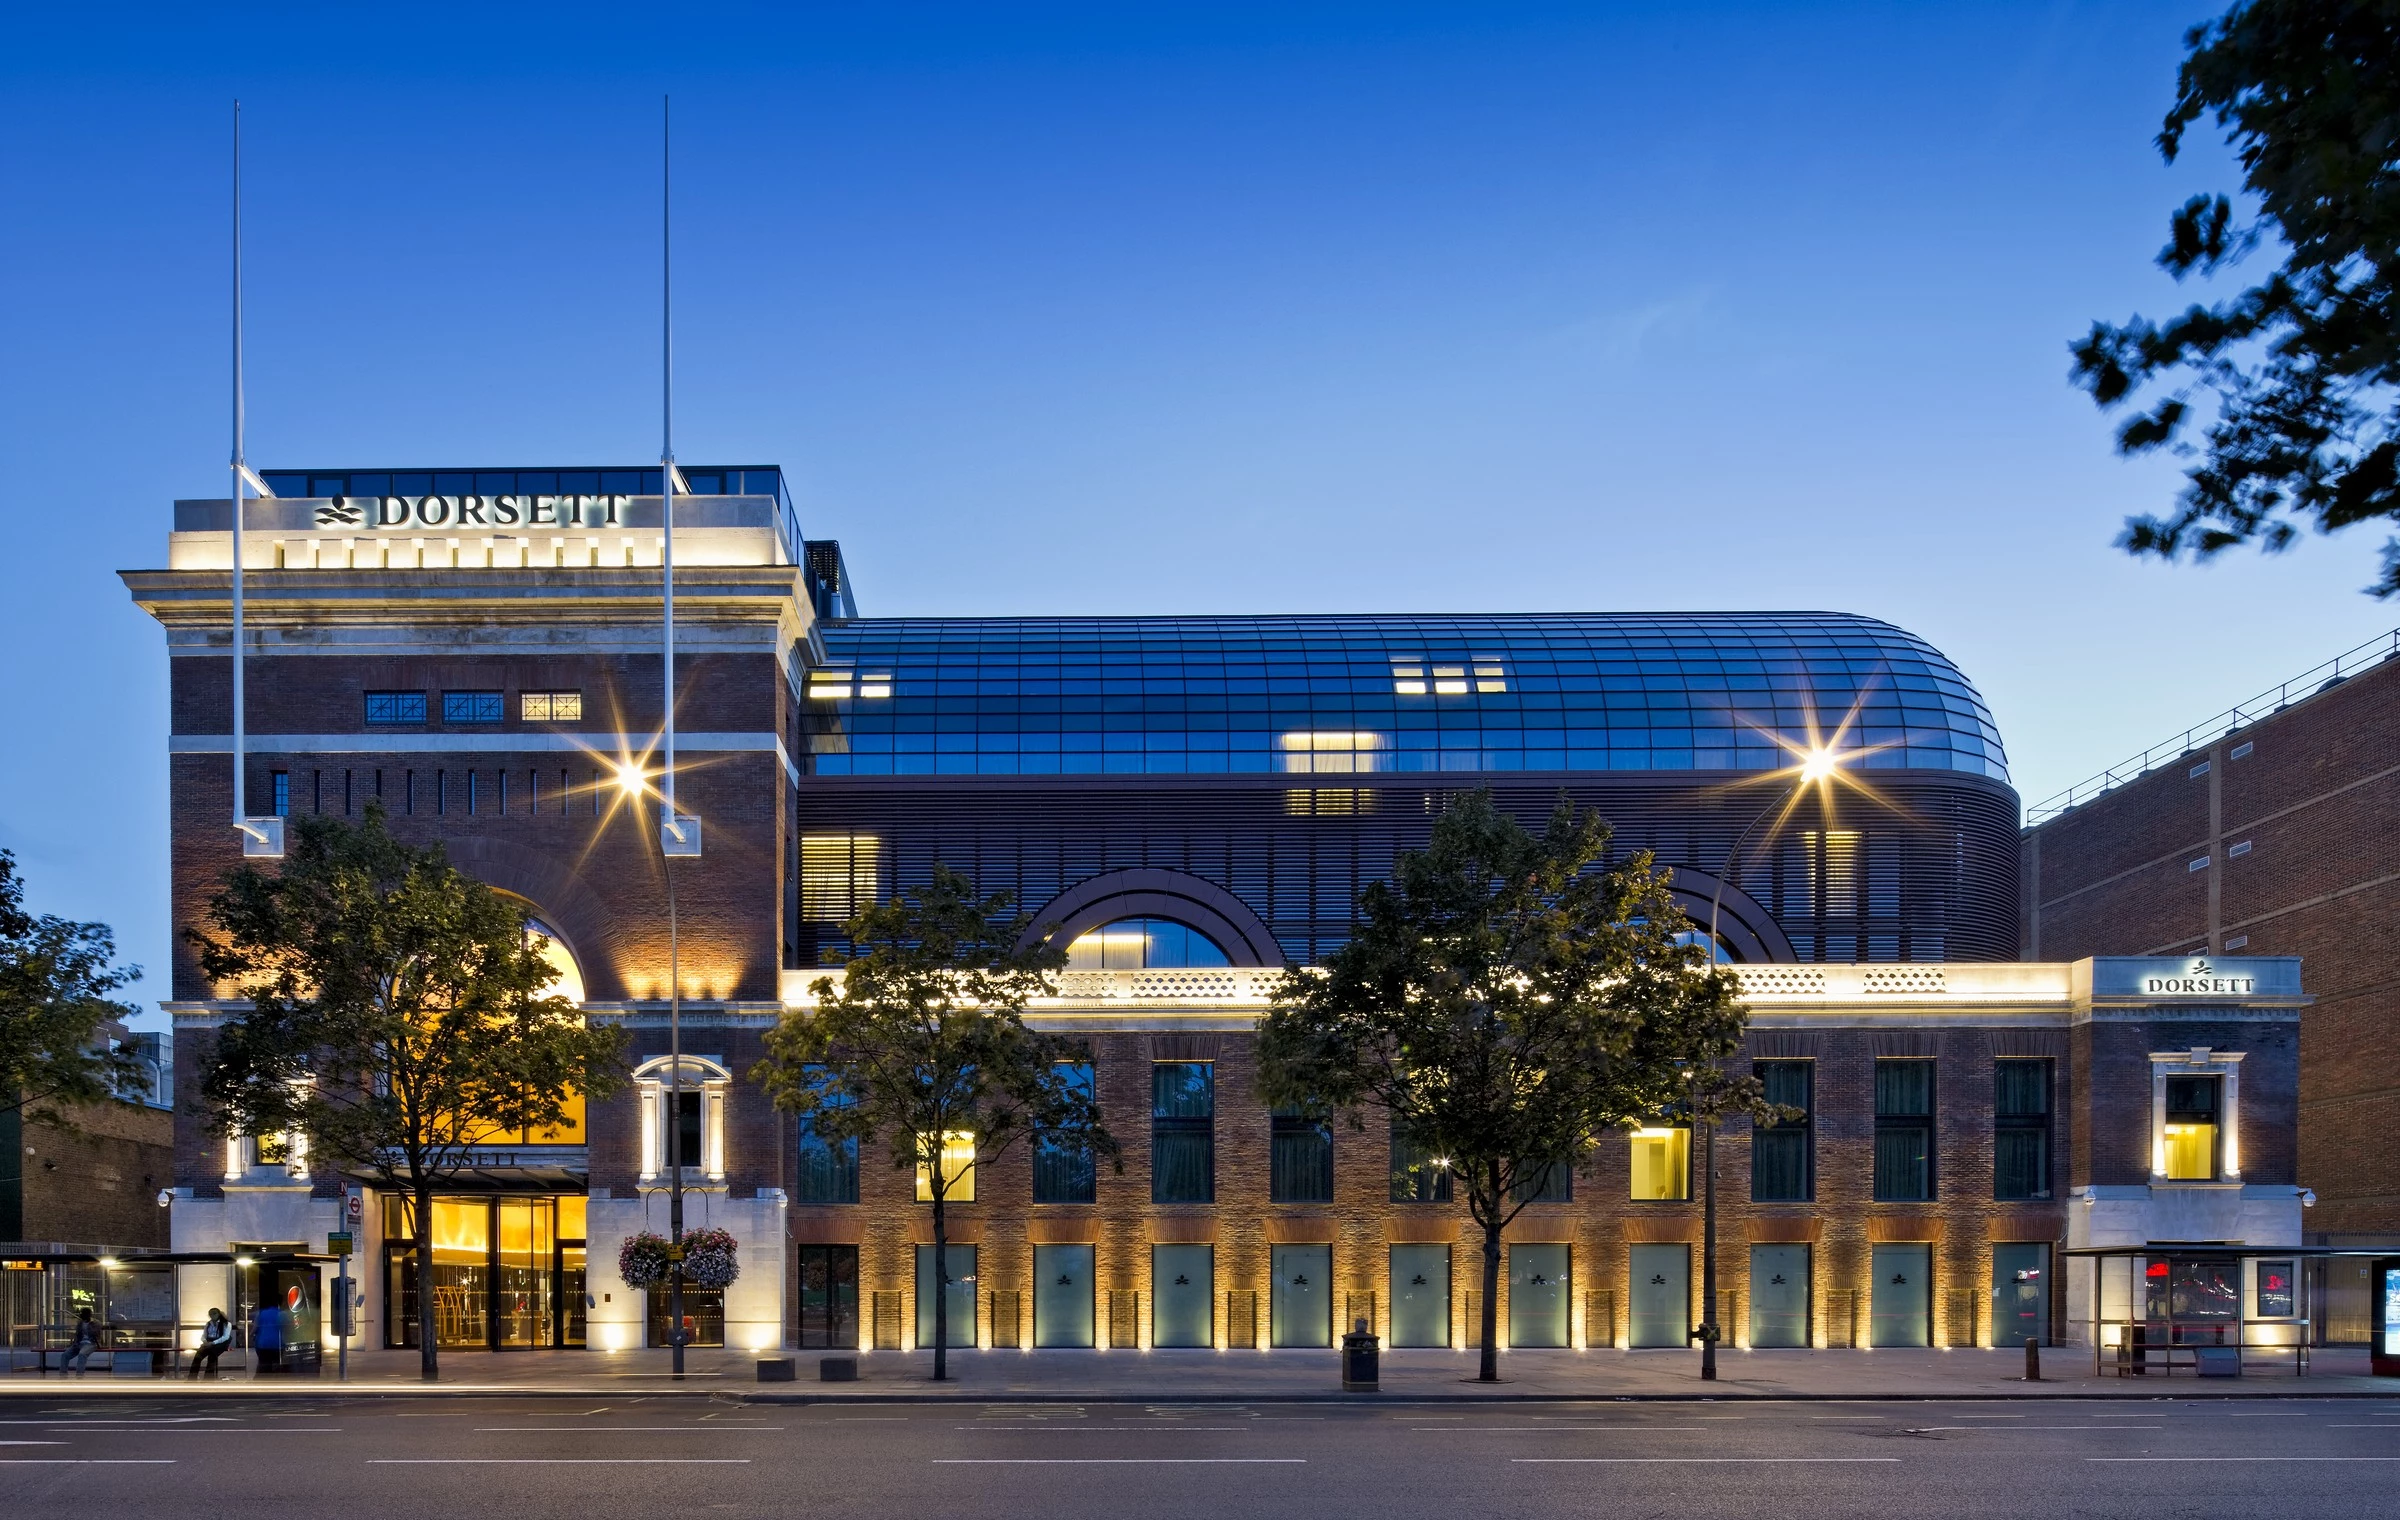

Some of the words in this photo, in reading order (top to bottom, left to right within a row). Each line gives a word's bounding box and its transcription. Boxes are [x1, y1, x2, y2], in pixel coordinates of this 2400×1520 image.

[377, 494, 626, 525] DORSETT
[2149, 979, 2254, 992] DORSETT
[418, 1153, 516, 1166] ORSETT
[341, 1182, 348, 1192] N
